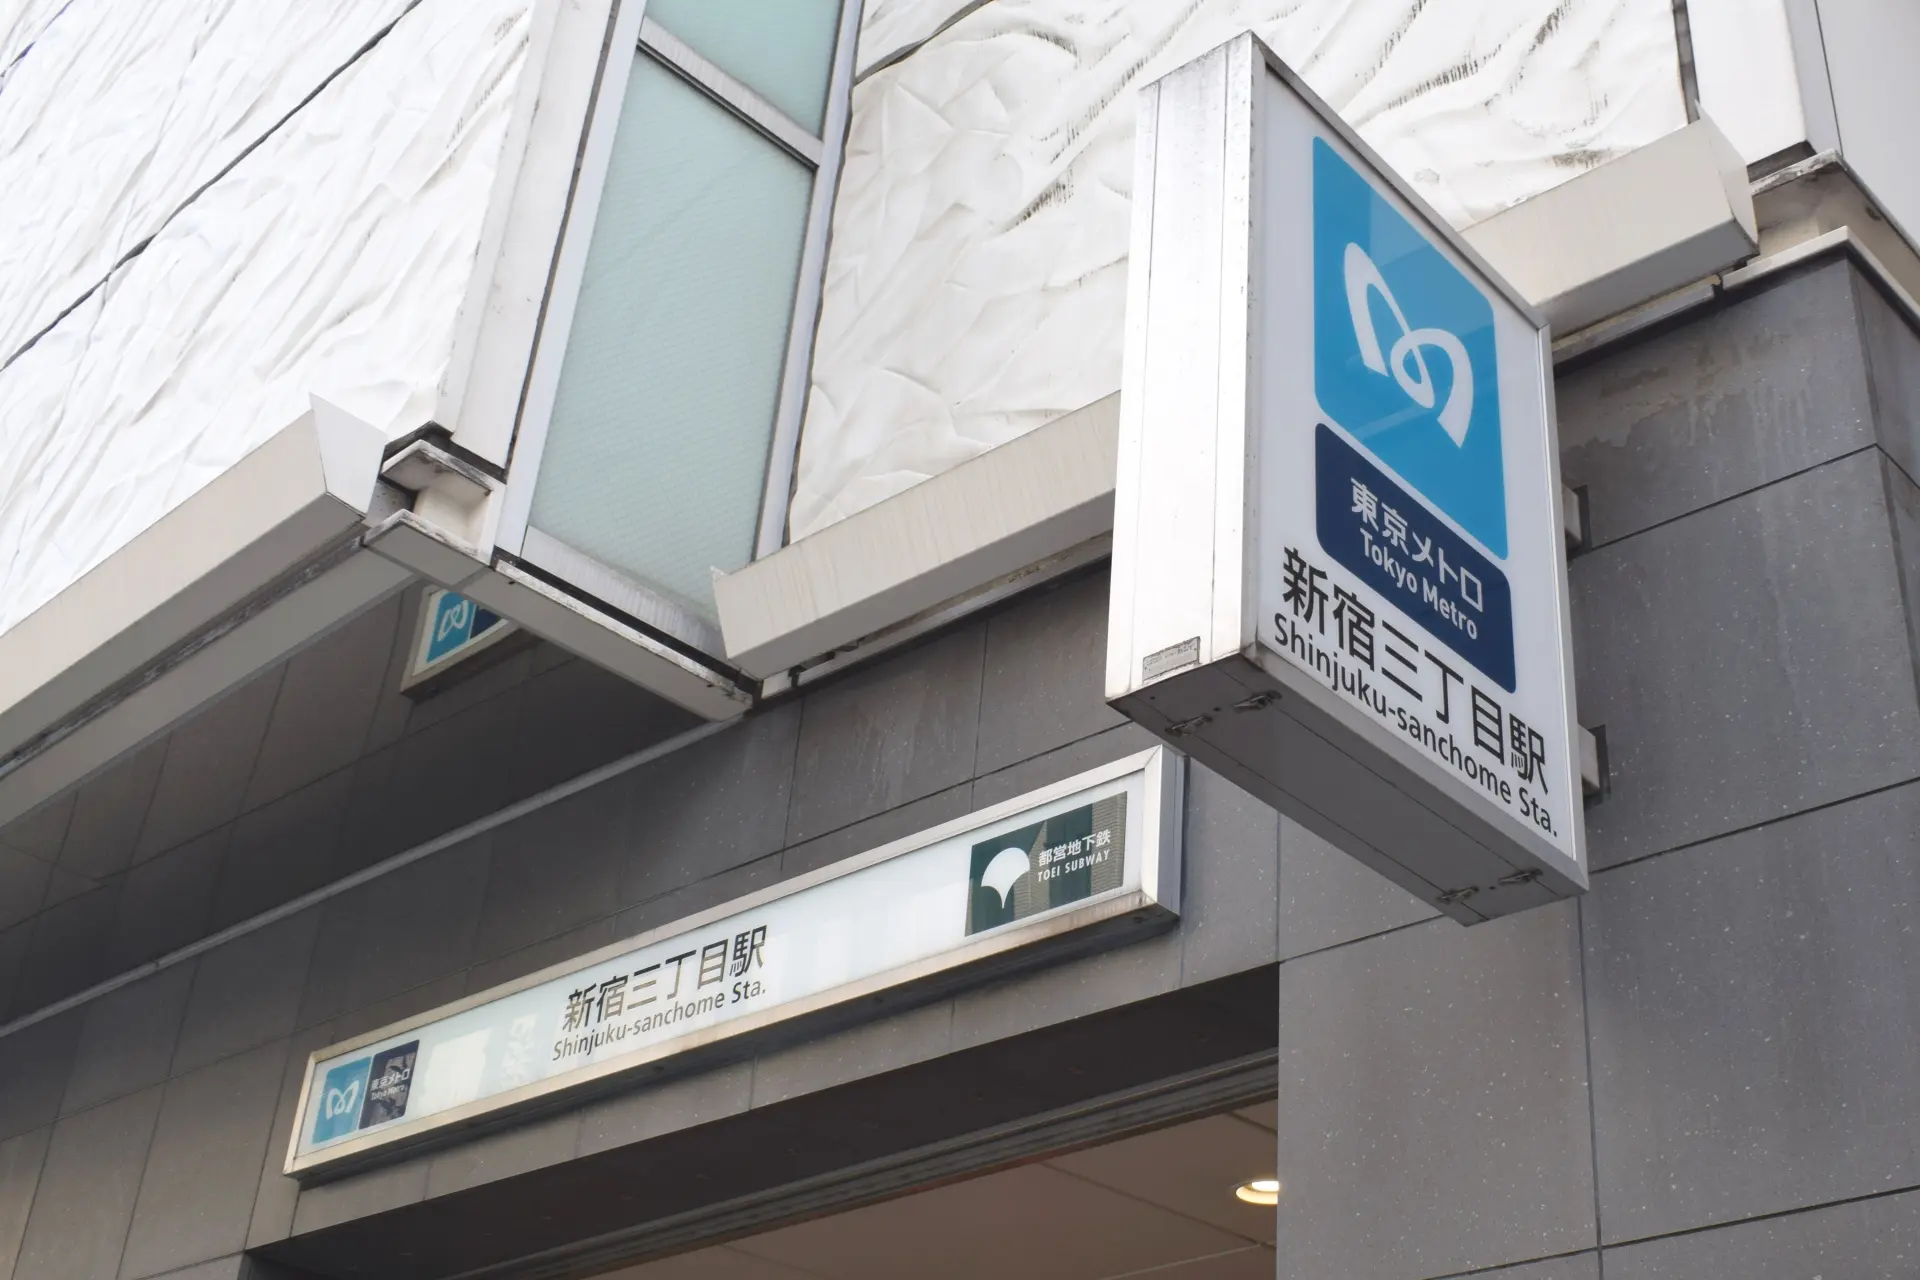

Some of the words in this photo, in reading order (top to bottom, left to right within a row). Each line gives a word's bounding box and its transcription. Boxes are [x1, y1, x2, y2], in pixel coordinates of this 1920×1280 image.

[1350, 477, 1483, 613] 東京メトロ
[1360, 528, 1418, 594] Tokyo
[1423, 577, 1478, 640] Metro
[1274, 612, 1512, 804] Shinjuku-sanchome
[1518, 786, 1558, 837] Sta.
[1282, 546, 1549, 795] 新宿三丁目駅
[1037, 865, 1060, 882] TOEI
[1065, 849, 1110, 873] SUBWAY
[1038, 828, 1111, 867] 都営地下鉄
[552, 991, 725, 1061] Shinjuku-sanchome
[731, 979, 766, 1004] Sta.
[562, 925, 768, 1033] 新宿三丁目駅
[371, 1068, 410, 1091] 東京メトロ
